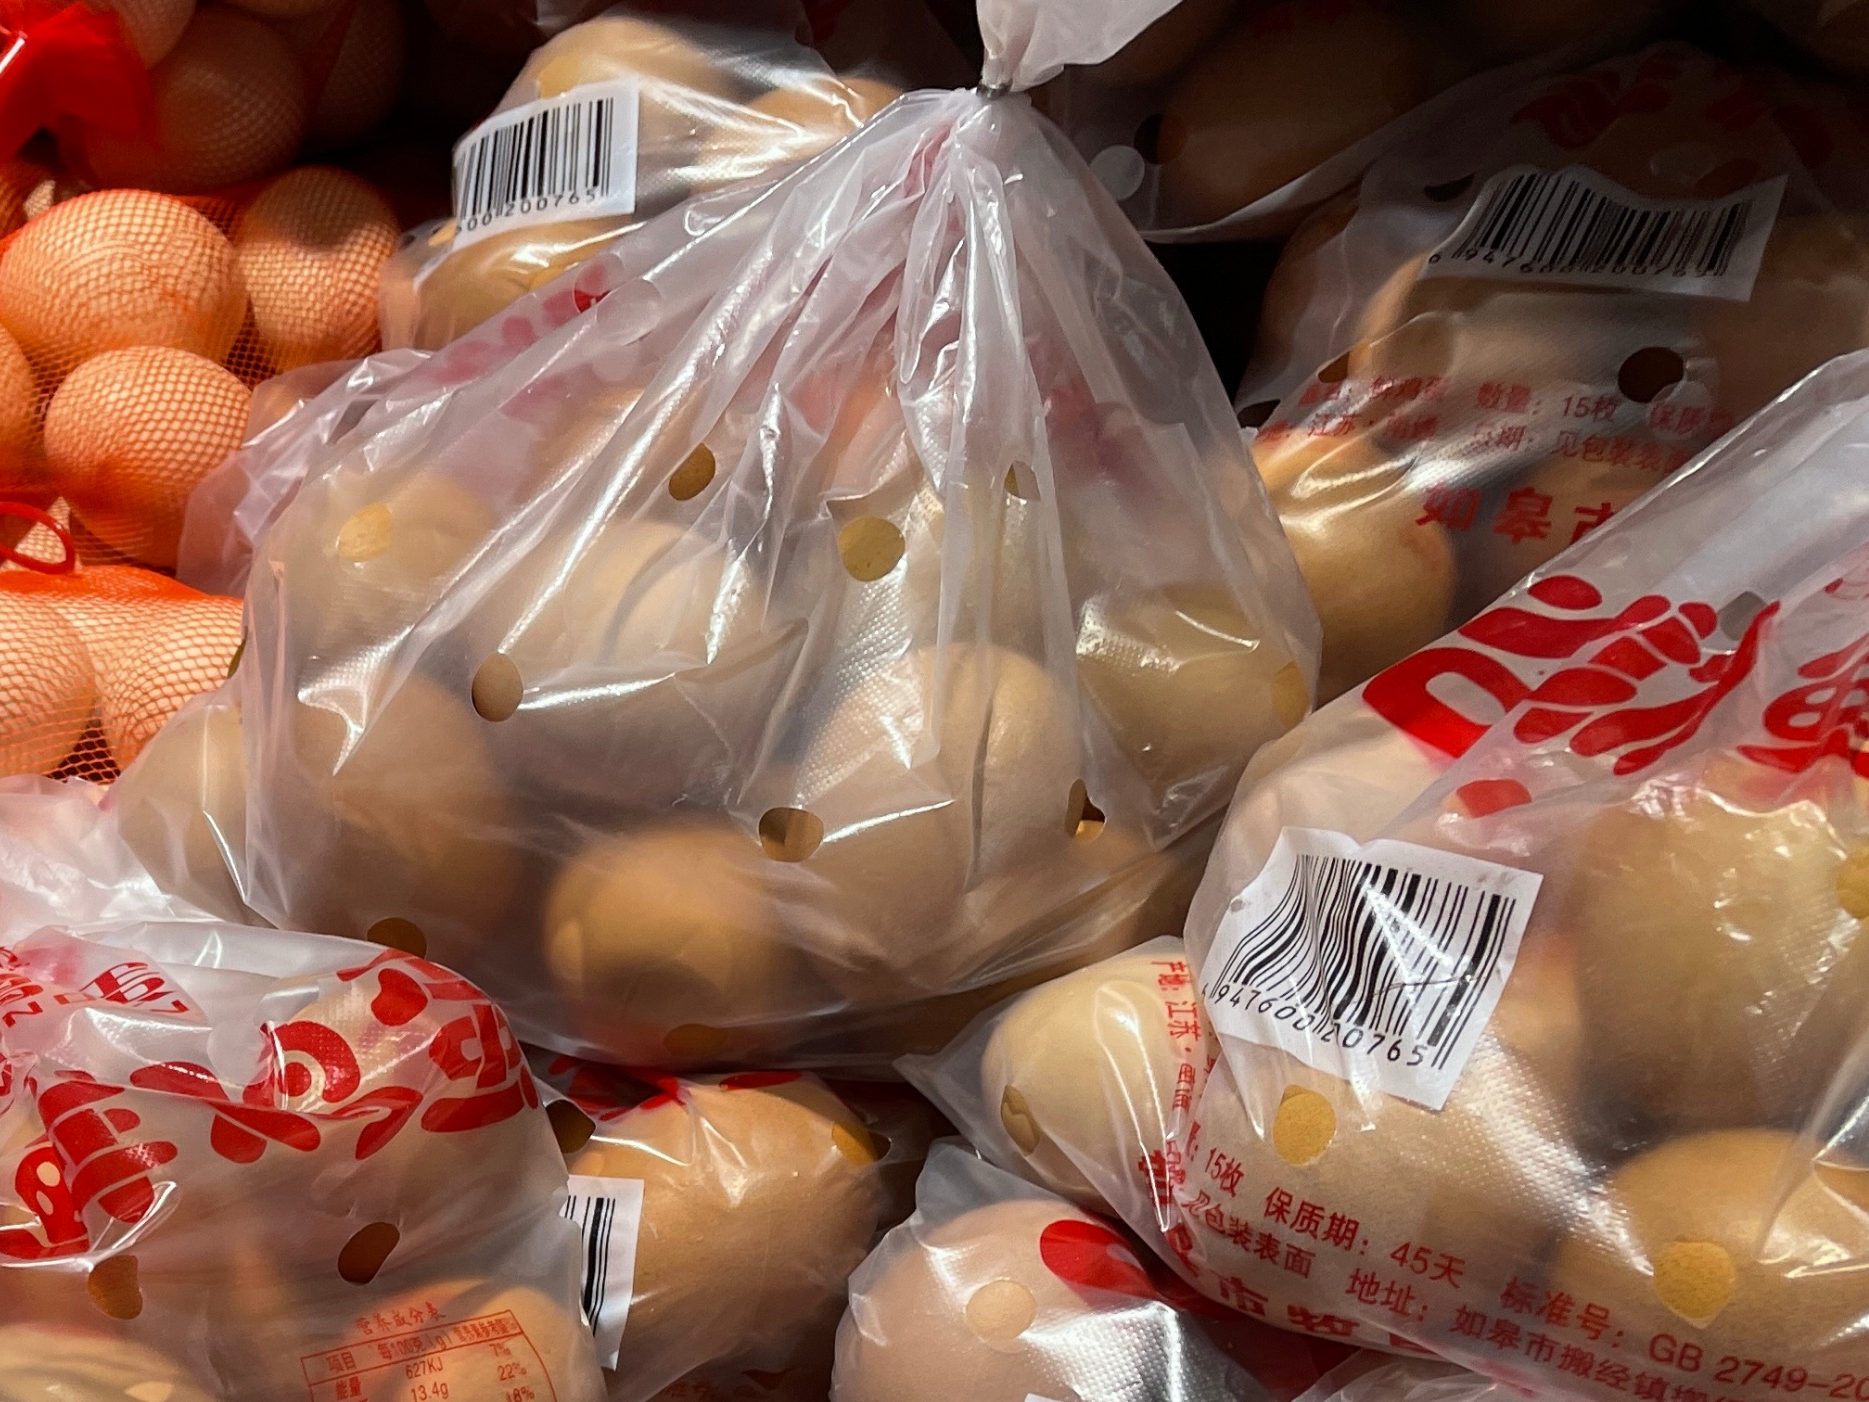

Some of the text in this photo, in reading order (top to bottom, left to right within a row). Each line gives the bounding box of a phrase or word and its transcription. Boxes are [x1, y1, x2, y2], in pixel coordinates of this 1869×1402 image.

[1264, 1187, 1467, 1288] 保质期：45天
[335, 1376, 362, 1400] 能量
[405, 1357, 444, 1379] 627KJ
[411, 1382, 449, 1402] 13.4g
[497, 1361, 527, 1381] 22%
